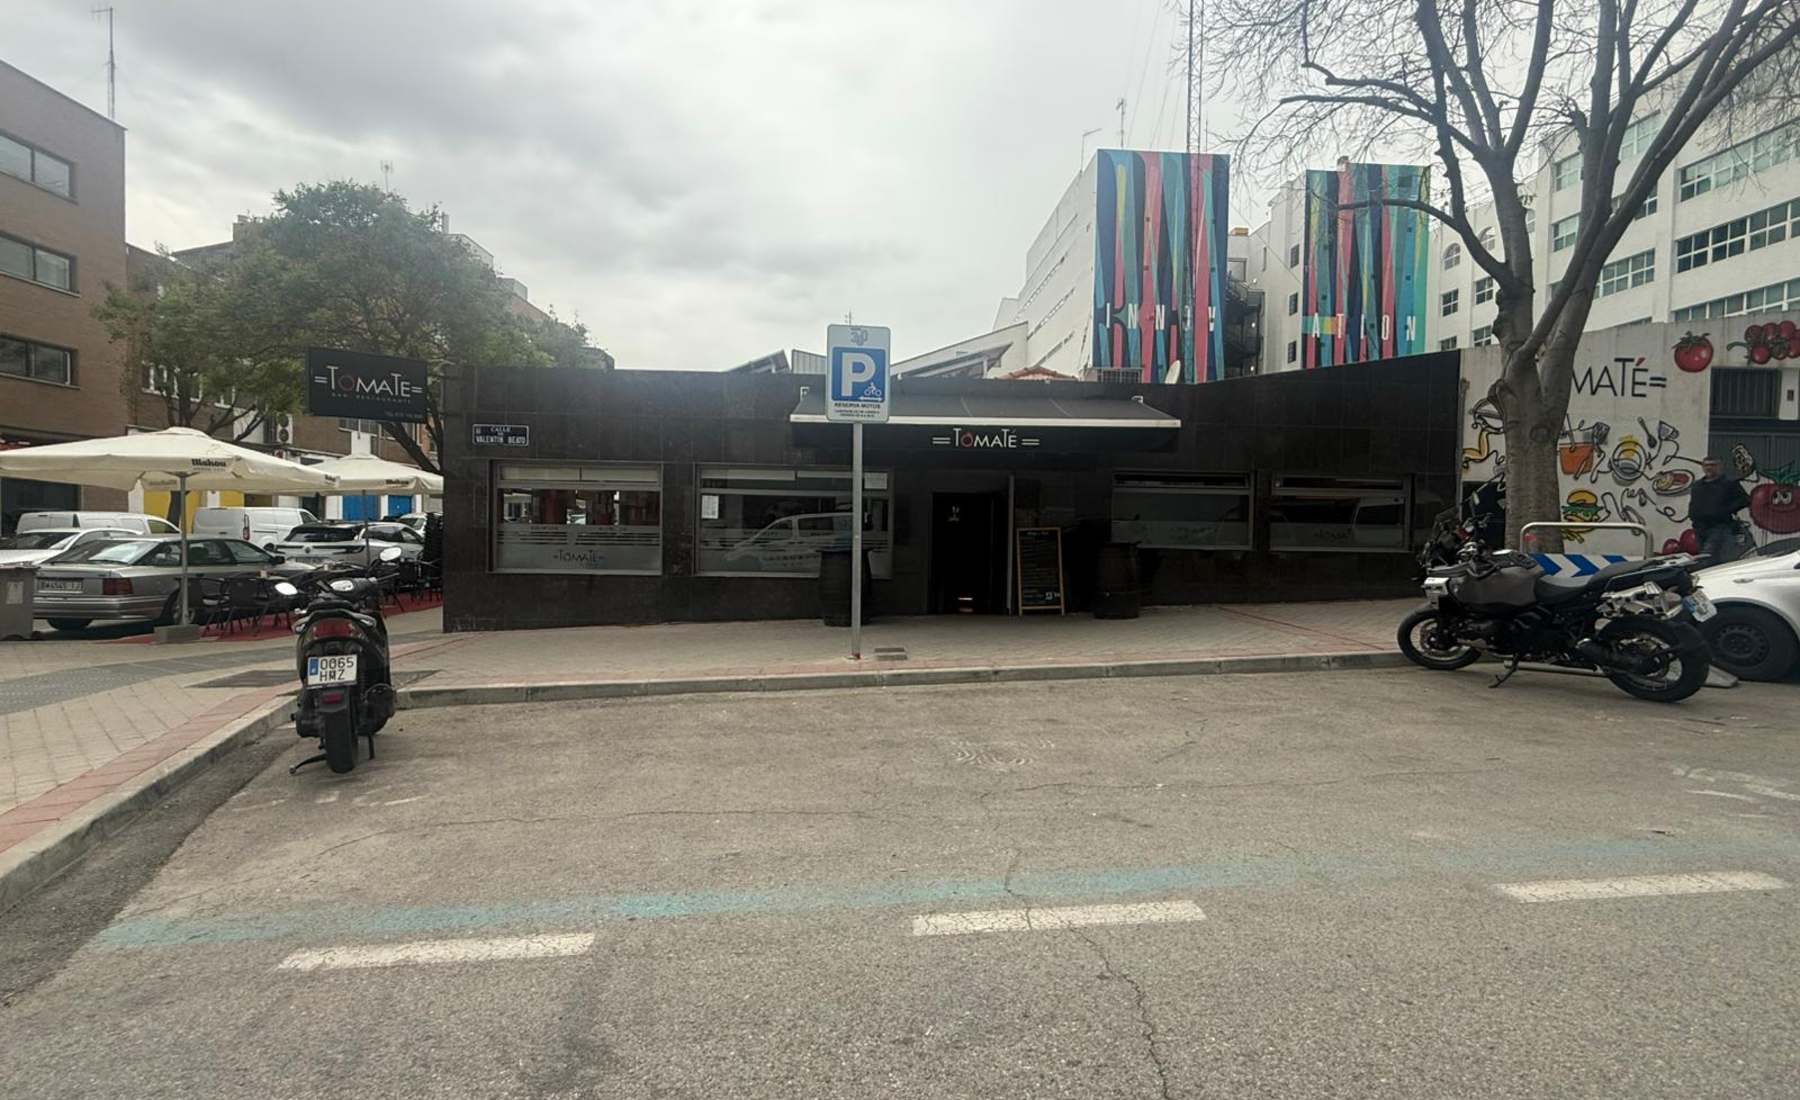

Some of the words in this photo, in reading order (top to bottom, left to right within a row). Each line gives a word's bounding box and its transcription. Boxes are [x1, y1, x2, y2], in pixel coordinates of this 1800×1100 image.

[1312, 312, 1416, 341] ATION
[841, 351, 876, 397] P
[1572, 357, 1648, 398] MATÉ
[191, 458, 226, 468] Mahou
[320, 657, 354, 670] 0065
[320, 669, 345, 682] HMZ
